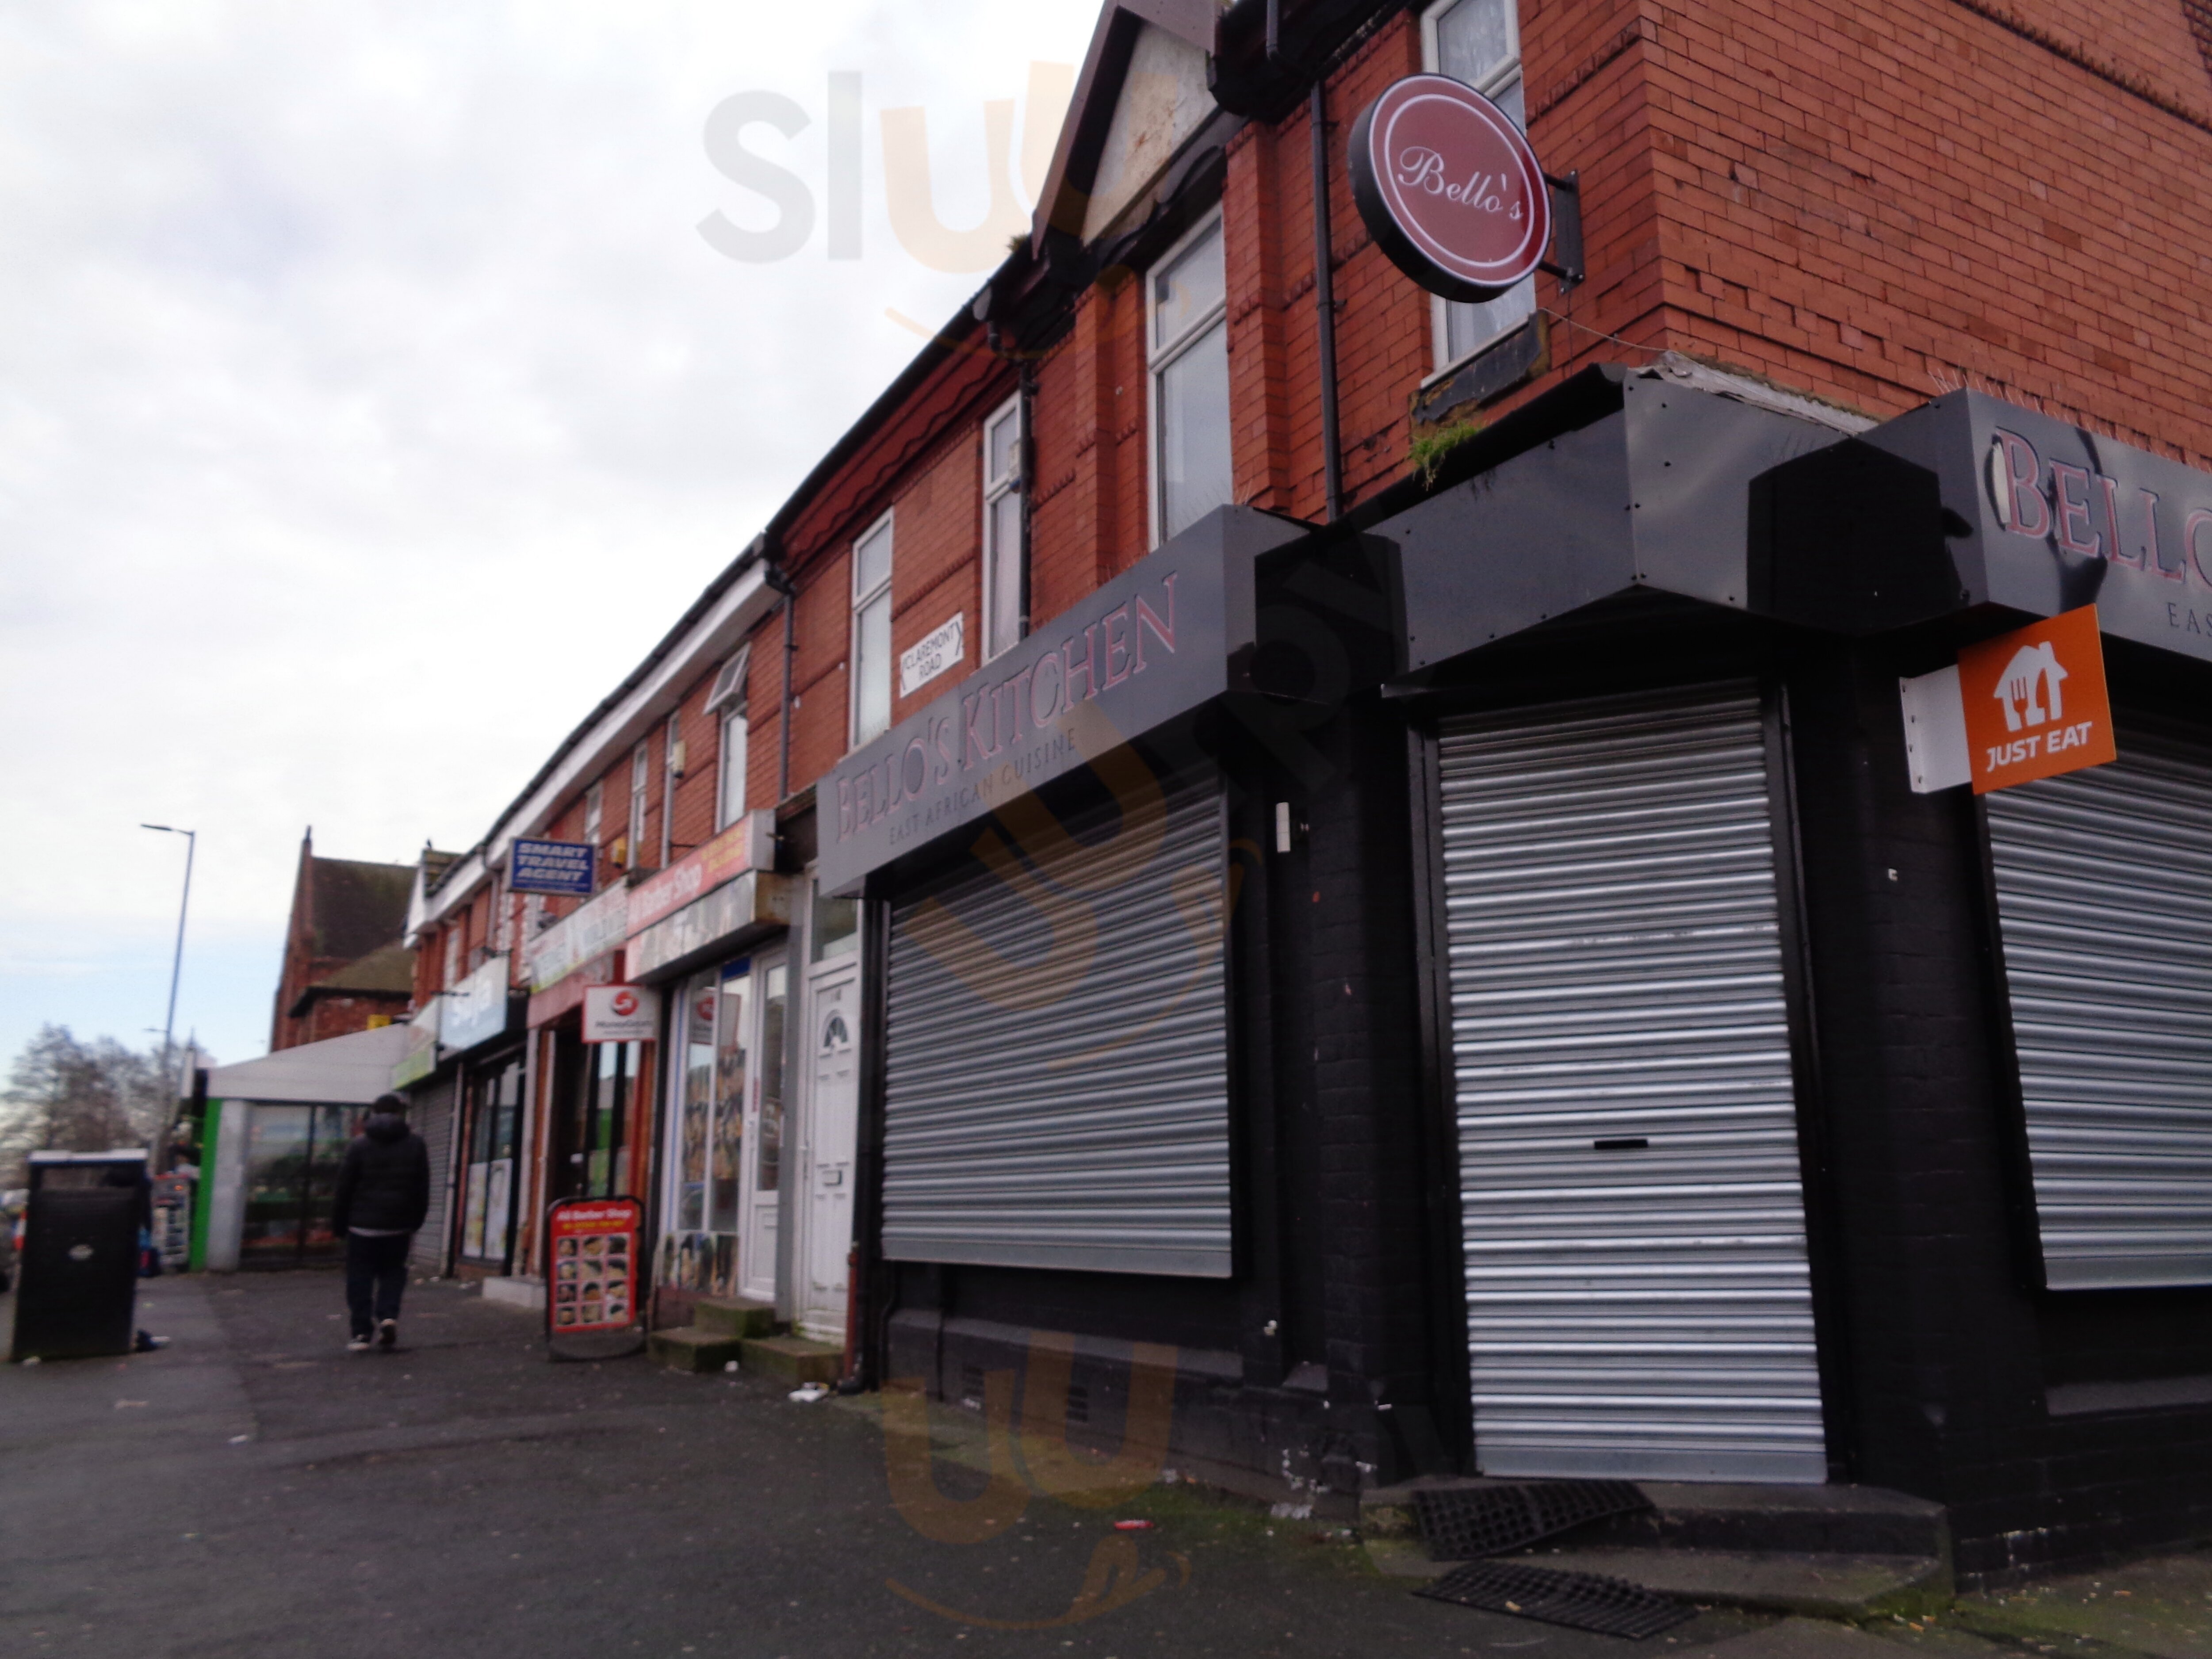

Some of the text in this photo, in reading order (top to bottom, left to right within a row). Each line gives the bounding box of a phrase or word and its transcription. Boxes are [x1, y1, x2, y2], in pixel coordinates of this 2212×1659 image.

[1397, 146, 1523, 220] Bello's
[905, 622, 955, 670] CLAREMONT
[919, 653, 941, 680] ROAD
[836, 570, 1178, 845] BELLO'S KITCHEN
[1986, 721, 2093, 772] JUST EAT
[889, 728, 1075, 845] EAST AFRICAN CUISINE
[517, 855, 589, 871] TRAVEL
[518, 842, 588, 858] SMART
[517, 867, 584, 882] AGENT
